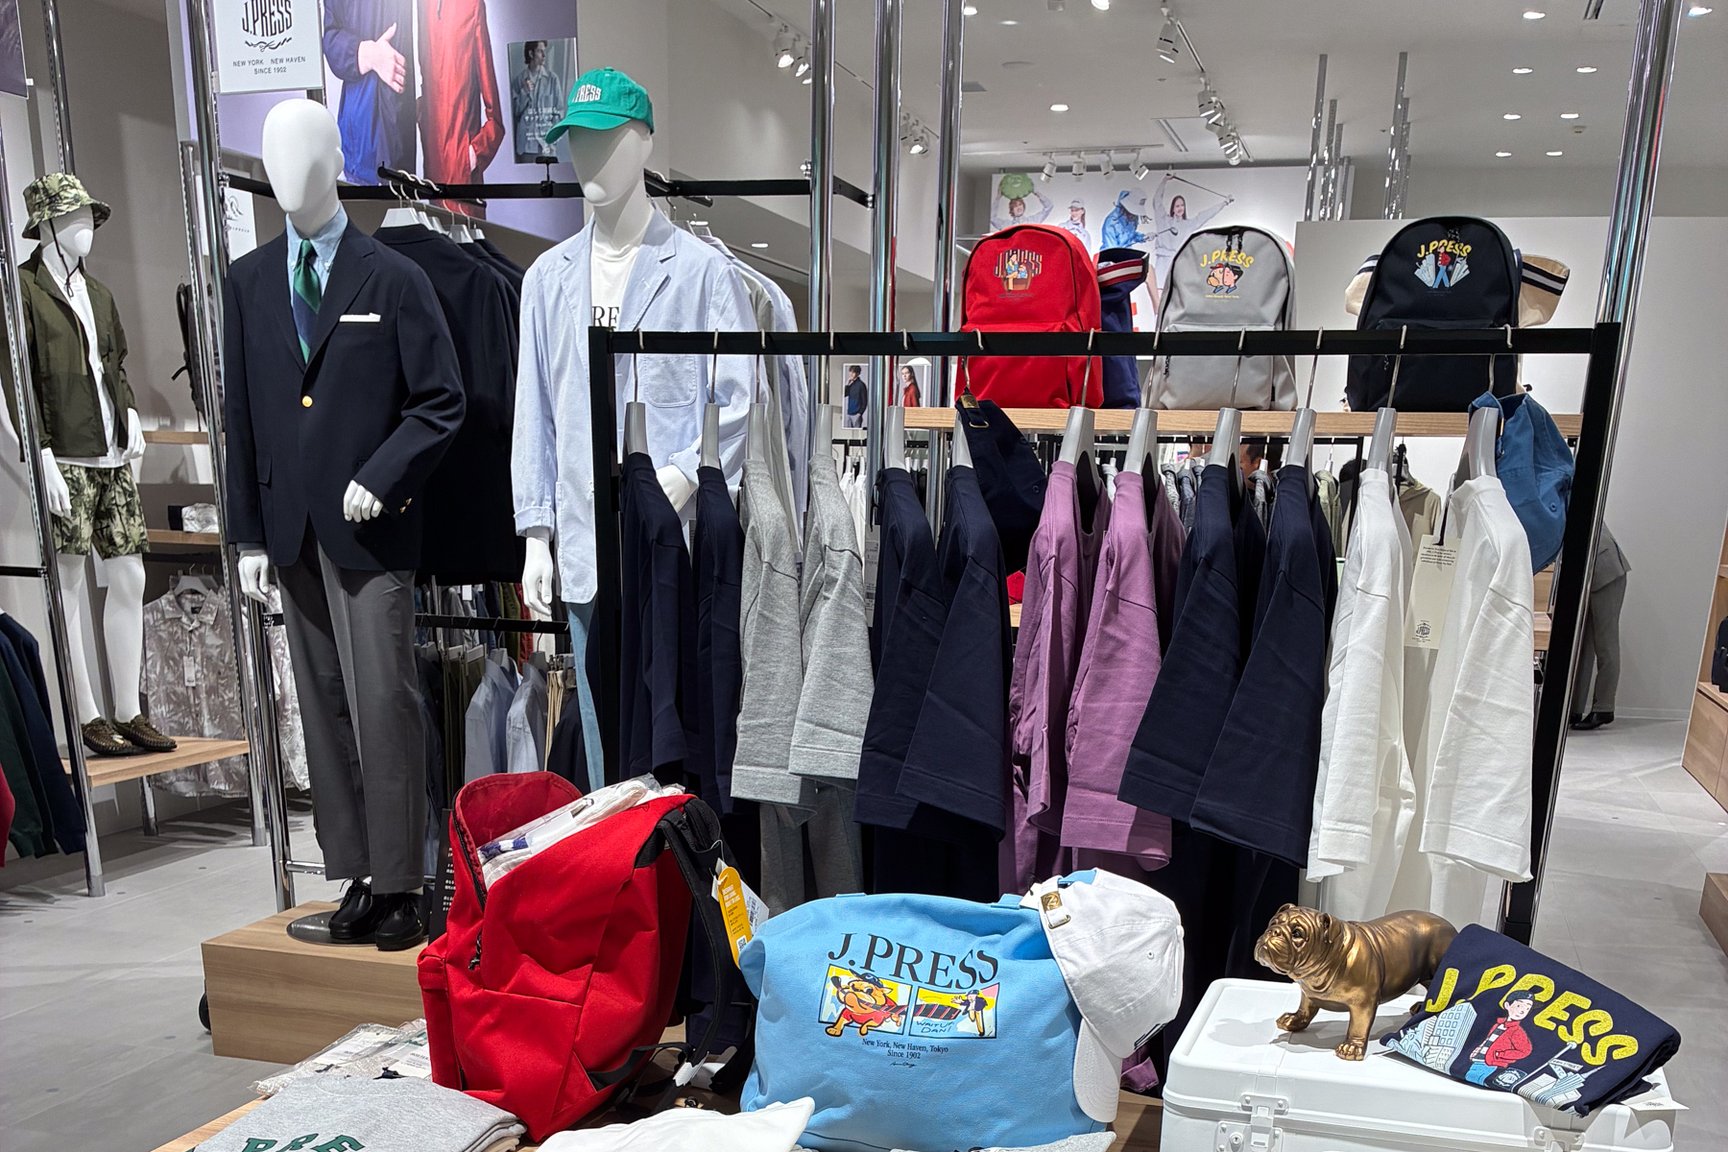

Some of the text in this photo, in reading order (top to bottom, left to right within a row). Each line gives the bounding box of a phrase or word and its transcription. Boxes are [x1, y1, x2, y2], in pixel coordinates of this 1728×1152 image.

[242, 0, 292, 37] J.PRESS
[273, 66, 287, 74] 1902
[828, 932, 999, 990] J.PRESS
[862, 1038, 876, 1046] New
[876, 1040, 891, 1048] York,
[907, 1043, 929, 1052] Haven,
[930, 1045, 949, 1054] Tokyo
[887, 1049, 921, 1059] Since 1902
